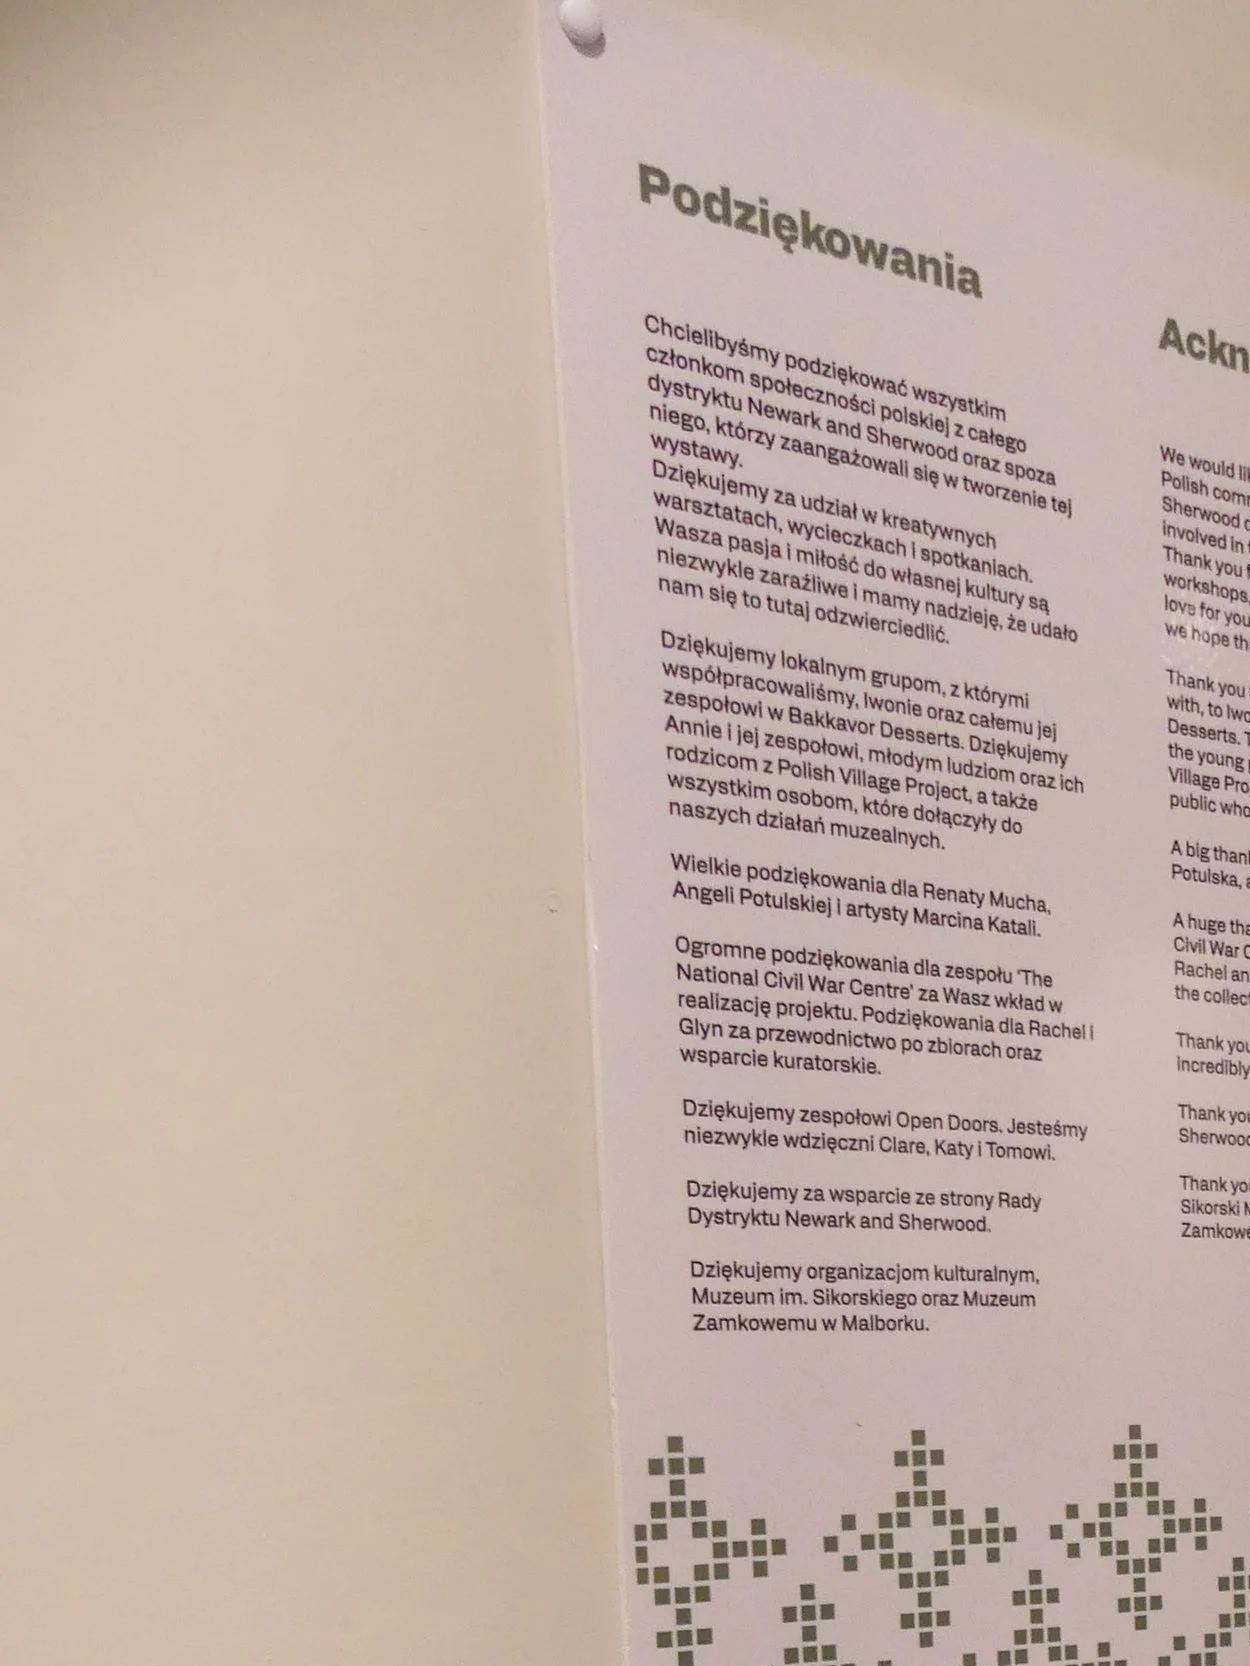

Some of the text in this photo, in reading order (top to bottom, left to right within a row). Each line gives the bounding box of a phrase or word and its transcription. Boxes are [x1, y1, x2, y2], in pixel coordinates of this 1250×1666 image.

[638, 163, 983, 299] Podziękowania
[644, 314, 1006, 422] Chcielibyśmy podziękować wszystkim
[648, 373, 1056, 486] dystryktu Newark and Sherwood oraz spoza
[1162, 496, 1240, 528] Sherwood
[664, 689, 1068, 769] zespołowi w Bakkavor Desserts. Dziękujemy
[670, 852, 1051, 915] Wielkie podziękowania dla Renaty Mucha,
[1172, 864, 1242, 890] Potulska,
[1175, 984, 1200, 1001] the
[1177, 1056, 1250, 1080] incredibly
[683, 1099, 1088, 1141] Dziękujemy zespołowi Open Doors. Jesteśmy
[688, 1206, 991, 1232] Dystryktu Newark and Sherwood.
[692, 1287, 1036, 1309] Muzeum im. Sikorskiego oraz Muzeum
[693, 1314, 929, 1331] Zamkowemu w Malborku.
